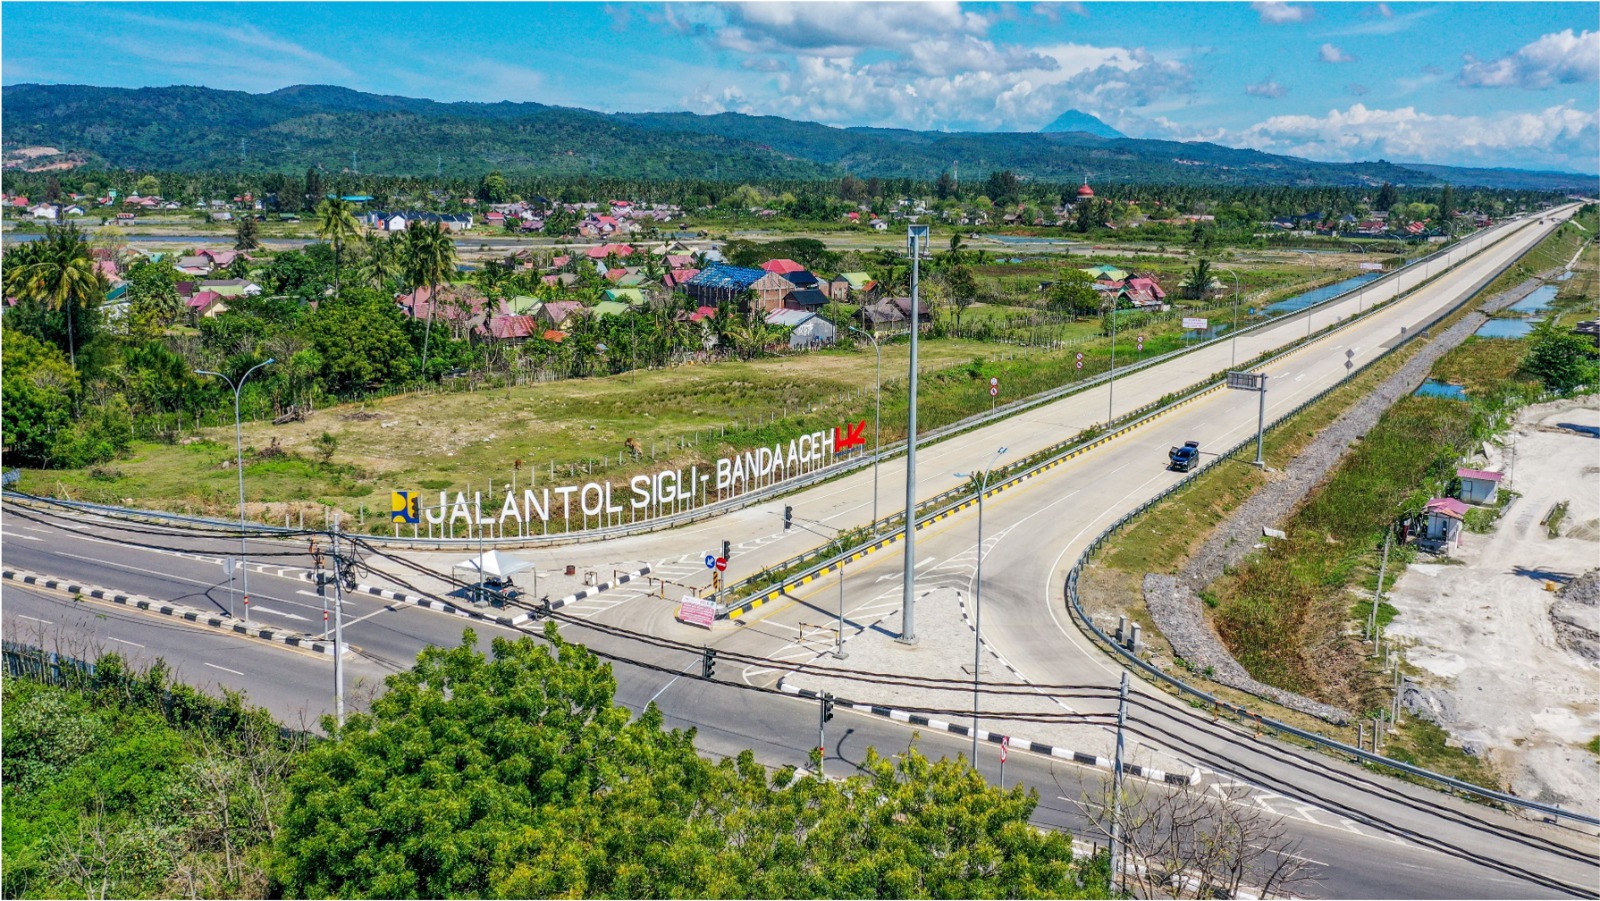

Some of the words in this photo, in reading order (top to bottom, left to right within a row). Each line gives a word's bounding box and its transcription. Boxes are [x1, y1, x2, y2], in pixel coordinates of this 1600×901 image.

[425, 488, 549, 524] JALAN
[554, 480, 623, 519] TOL
[630, 466, 697, 508] SIGLI
[716, 443, 784, 489] BANDA
[786, 428, 835, 467] ACEH
